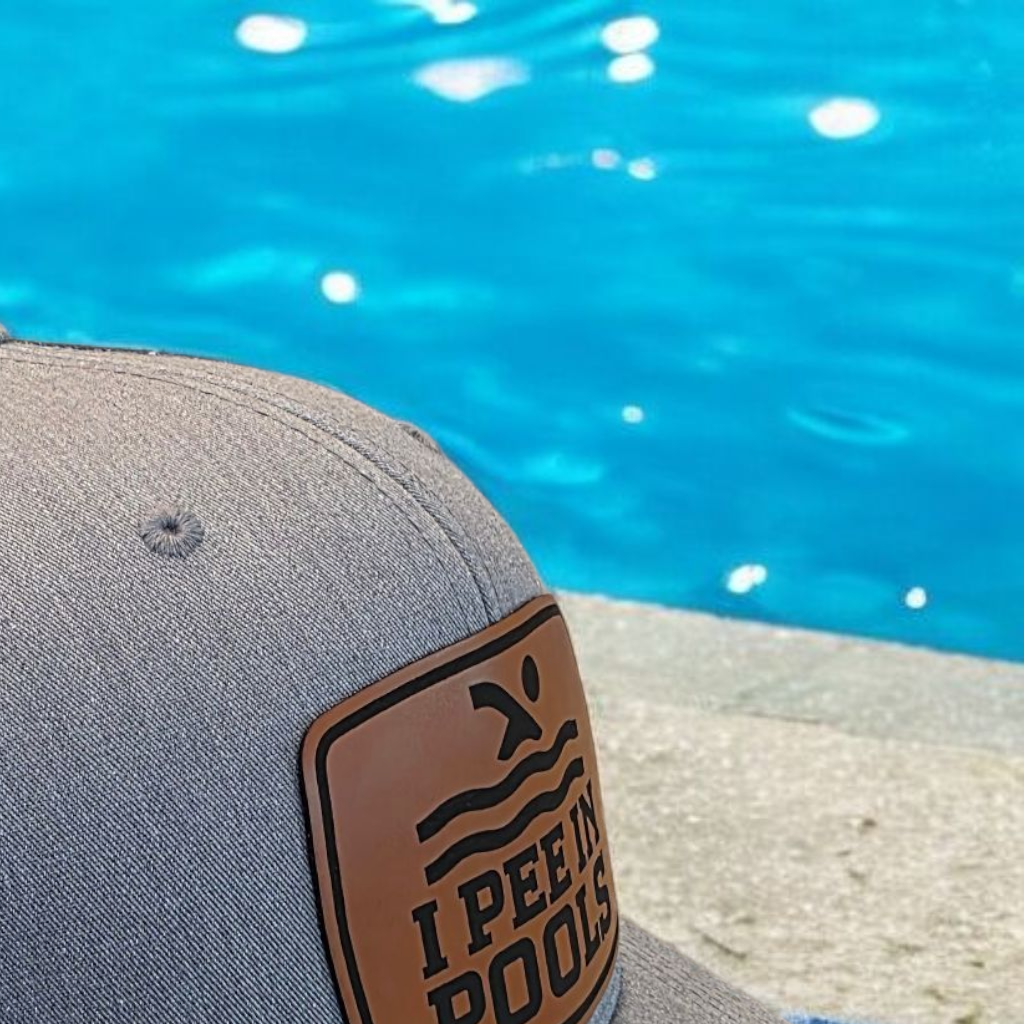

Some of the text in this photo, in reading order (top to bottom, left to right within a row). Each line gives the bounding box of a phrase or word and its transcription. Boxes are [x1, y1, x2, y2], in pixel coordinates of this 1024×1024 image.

[412, 779, 603, 980] I PEE IN
